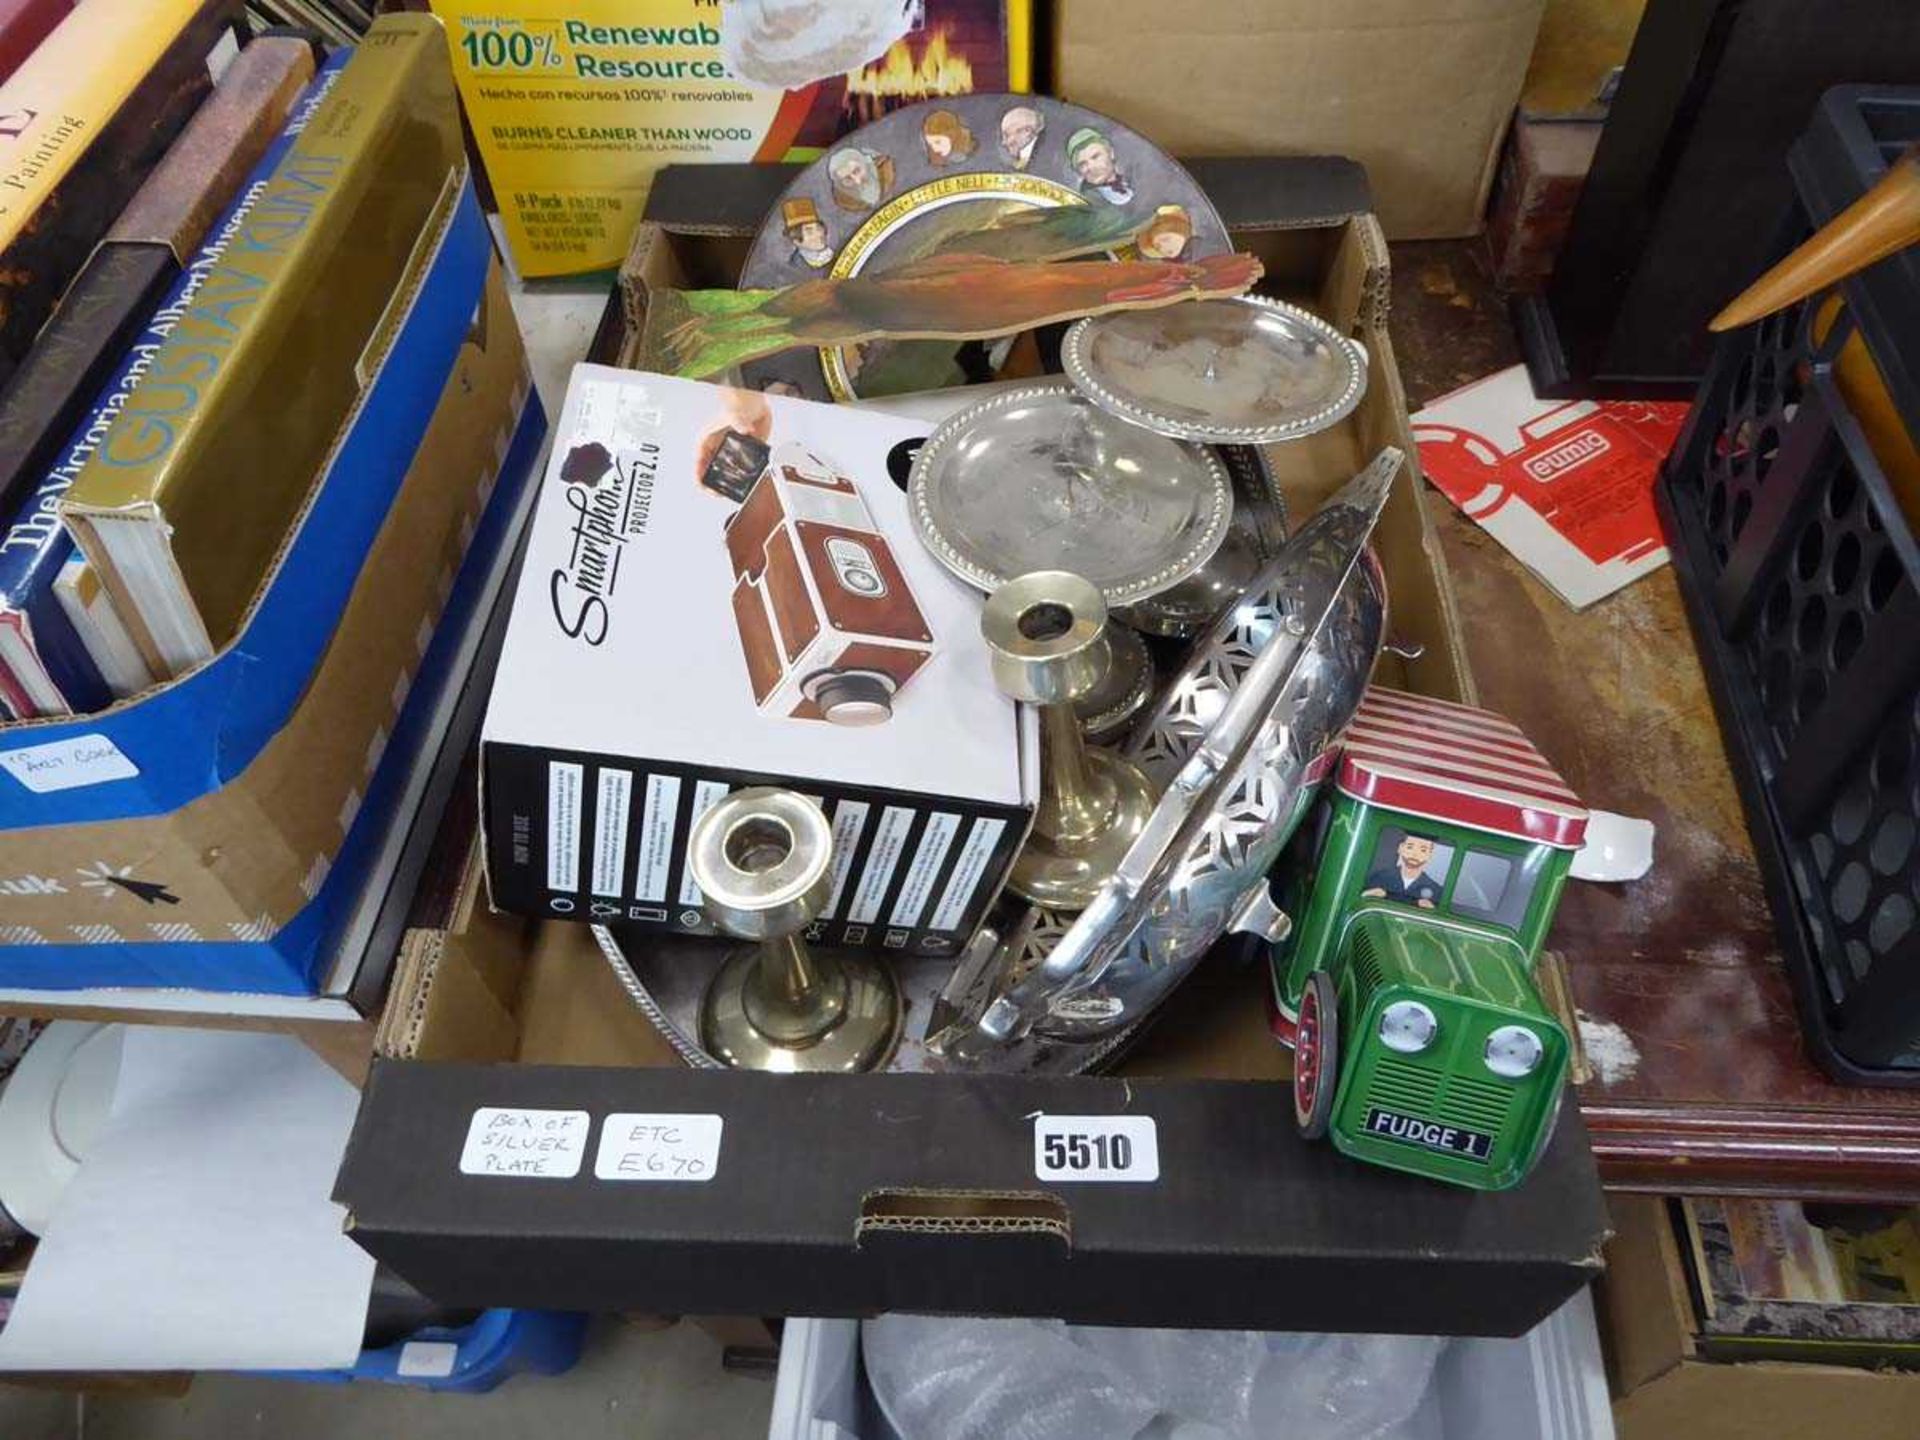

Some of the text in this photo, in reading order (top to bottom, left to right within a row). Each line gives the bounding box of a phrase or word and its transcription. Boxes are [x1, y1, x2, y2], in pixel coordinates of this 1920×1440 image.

[480, 89, 526, 100] Hecho
[529, 91, 555, 100] con
[558, 90, 620, 101] recursos
[672, 89, 753, 101] renovables
[492, 126, 752, 140] BURNS CLEANER THAN WOOD
[3, 115, 86, 190] Painting
[0, 496, 60, 553] The
[36, 389, 130, 497] Victoria
[119, 343, 162, 389] and
[148, 264, 208, 338] Albert
[192, 179, 268, 272] Museum
[100, 264, 268, 468] GUSTAV
[629, 471, 656, 535] PROJECTOR
[488, 1114, 533, 1129] BOX
[1374, 1111, 1478, 1153] FUDGE 1
[481, 1133, 571, 1151] SILVER
[628, 1125, 684, 1144] ETC
[1044, 1133, 1132, 1170] 5510
[485, 1154, 550, 1174] PLATE
[617, 1152, 705, 1176] E670
